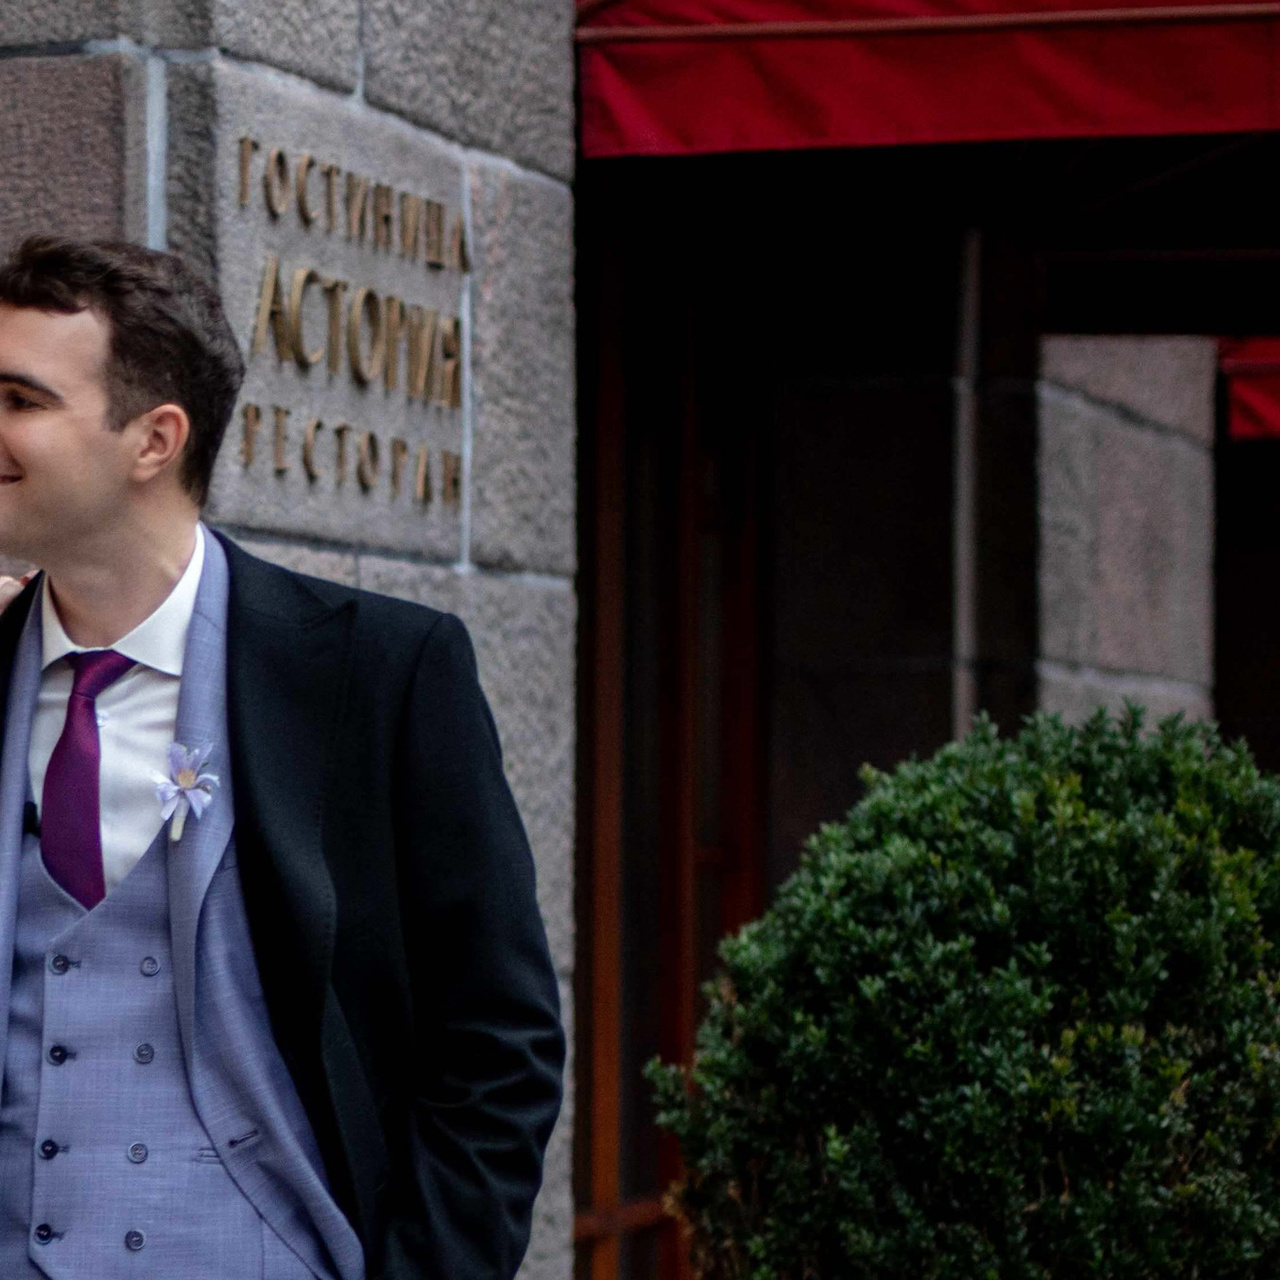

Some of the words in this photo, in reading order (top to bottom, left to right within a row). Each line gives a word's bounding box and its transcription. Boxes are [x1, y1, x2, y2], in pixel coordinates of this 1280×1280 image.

[239, 136, 470, 273] ГОСТИНИЦА
[251, 255, 462, 409] АСТОРИЯ
[241, 403, 462, 507] РЕСТОРАН
